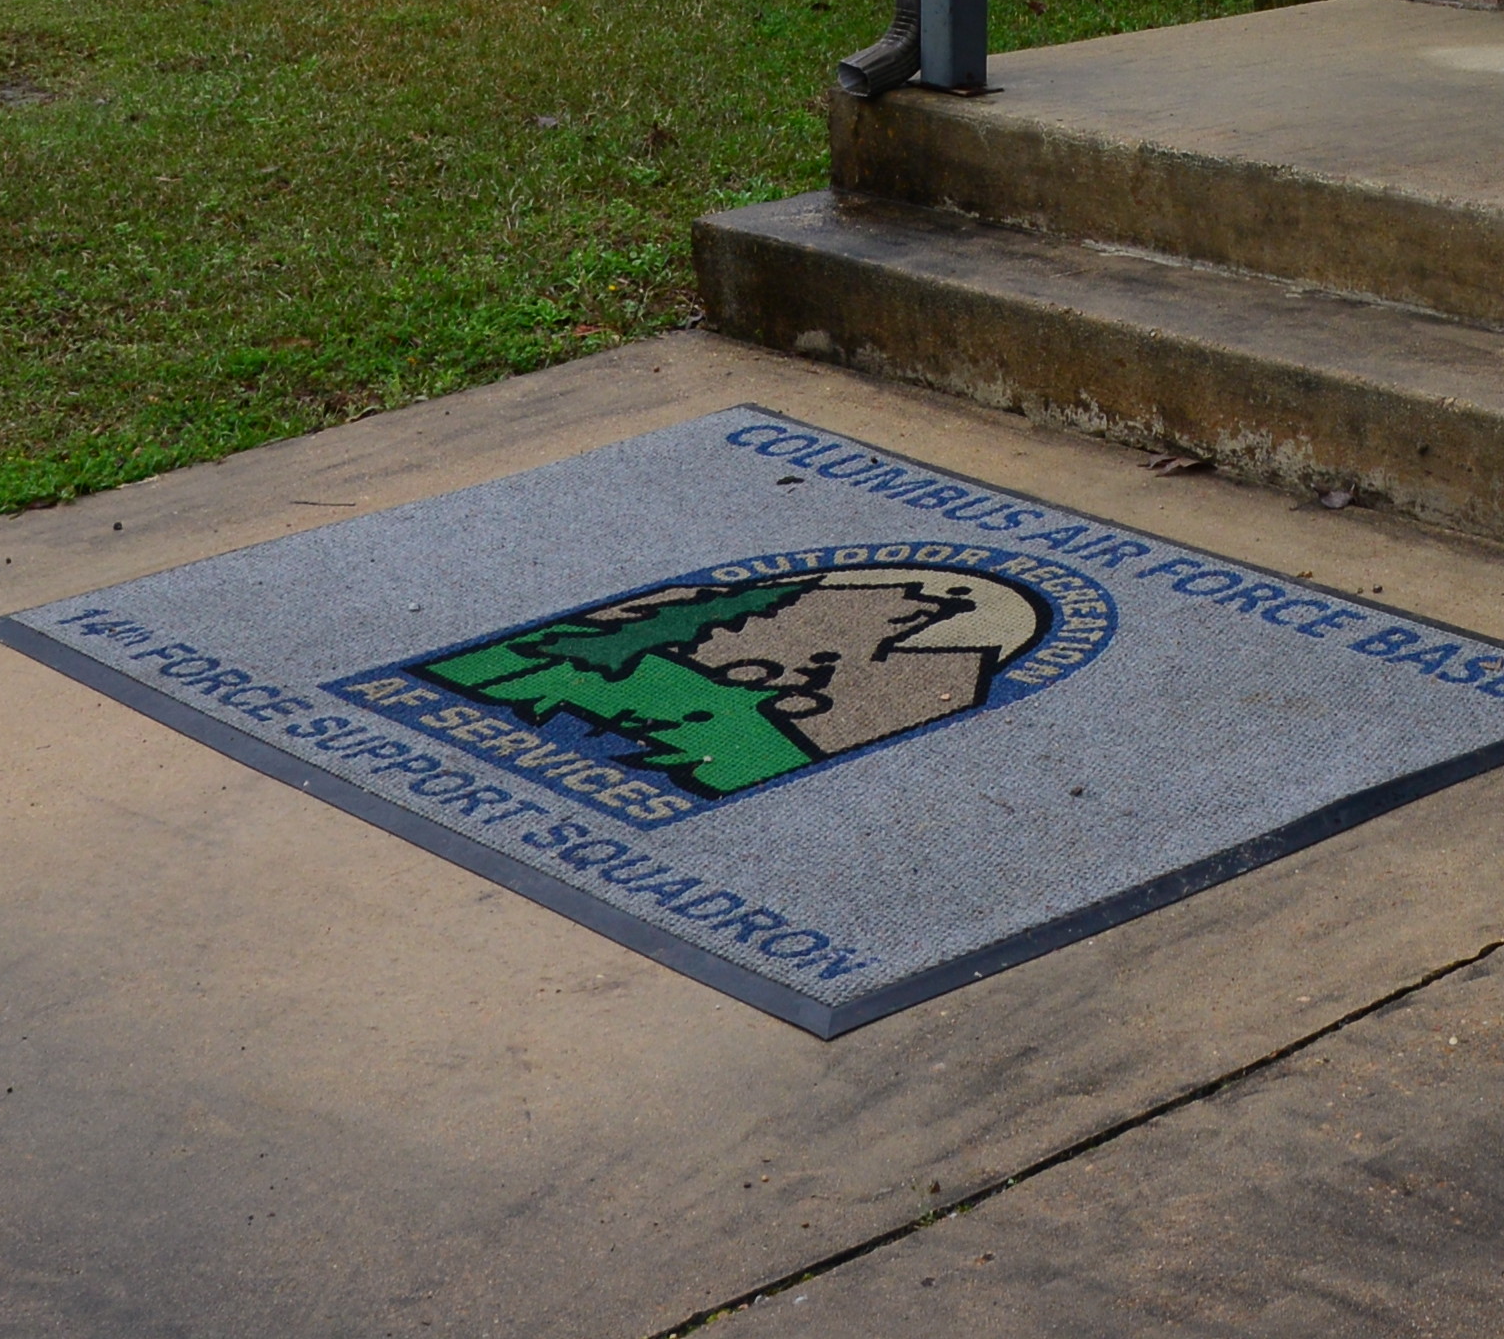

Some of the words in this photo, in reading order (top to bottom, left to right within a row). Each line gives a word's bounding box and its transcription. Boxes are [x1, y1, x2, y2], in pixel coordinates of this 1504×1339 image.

[711, 544, 991, 582] OUTDOOR
[991, 555, 1109, 686] RECREATION
[726, 424, 1045, 532] COLUMBUS
[1019, 524, 1152, 568] AIR
[1137, 557, 1367, 639] FORCE
[61, 608, 153, 647] 14th
[130, 642, 315, 723] FORCE
[286, 715, 551, 826] SUPPORT
[521, 821, 882, 981] SQUADRON
[346, 676, 440, 707] AF
[419, 705, 693, 821] SERVICES
